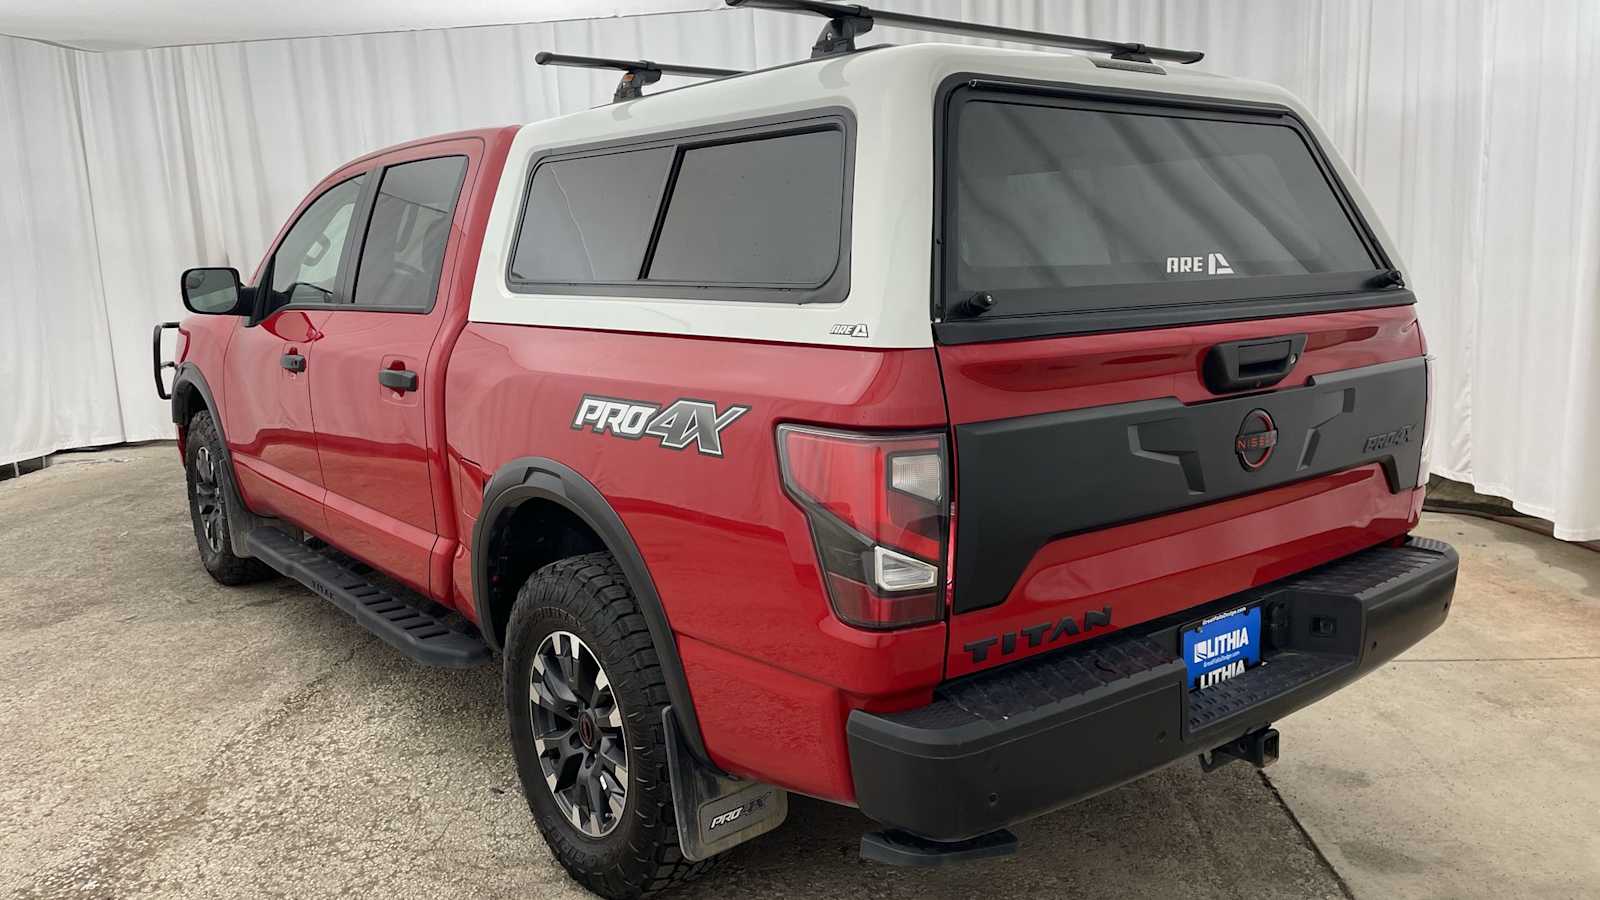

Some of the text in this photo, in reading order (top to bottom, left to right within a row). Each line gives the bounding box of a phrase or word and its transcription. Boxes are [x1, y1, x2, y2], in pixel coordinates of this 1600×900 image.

[1166, 256, 1203, 273] ARE
[1236, 433, 1277, 449] NISS
[963, 606, 1112, 663] TITAN
[1207, 626, 1248, 659] LITHIA
[1200, 660, 1246, 689] LITHIA
